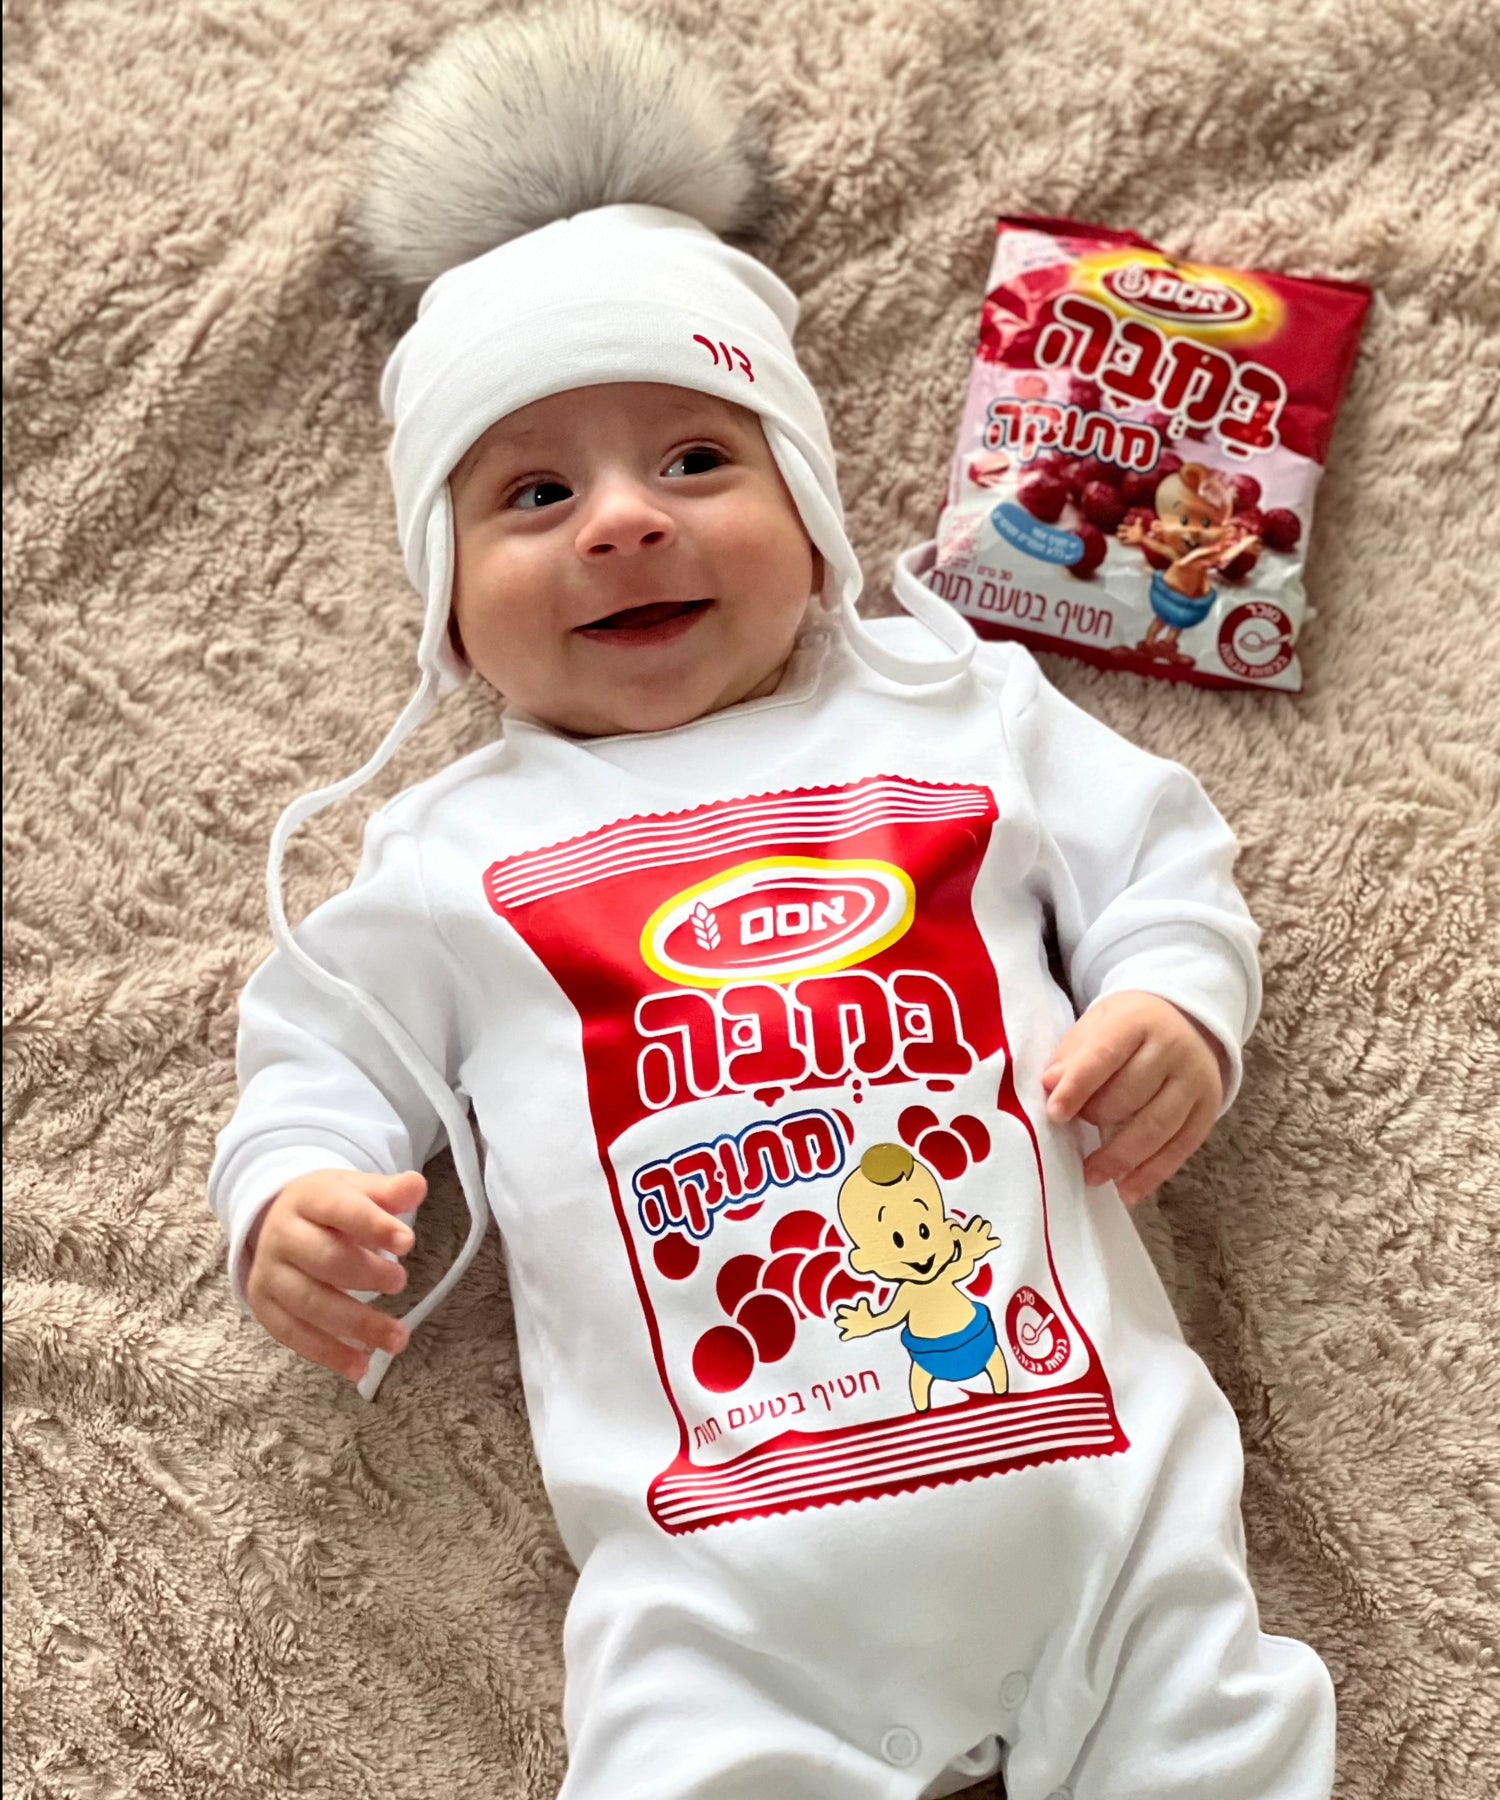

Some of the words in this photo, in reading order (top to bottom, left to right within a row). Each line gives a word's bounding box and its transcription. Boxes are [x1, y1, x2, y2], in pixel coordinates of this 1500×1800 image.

[1149, 277, 1227, 312] אסם
[692, 333, 755, 383] דור
[977, 582, 1047, 623] בטעם
[1054, 599, 1114, 640] חטיף
[740, 895, 848, 946] אסם
[1016, 1289, 1036, 1306] סוכר
[1044, 1338, 1068, 1372] בכמות
[727, 1391, 807, 1430] בטעם
[811, 1370, 881, 1412] חטיף
